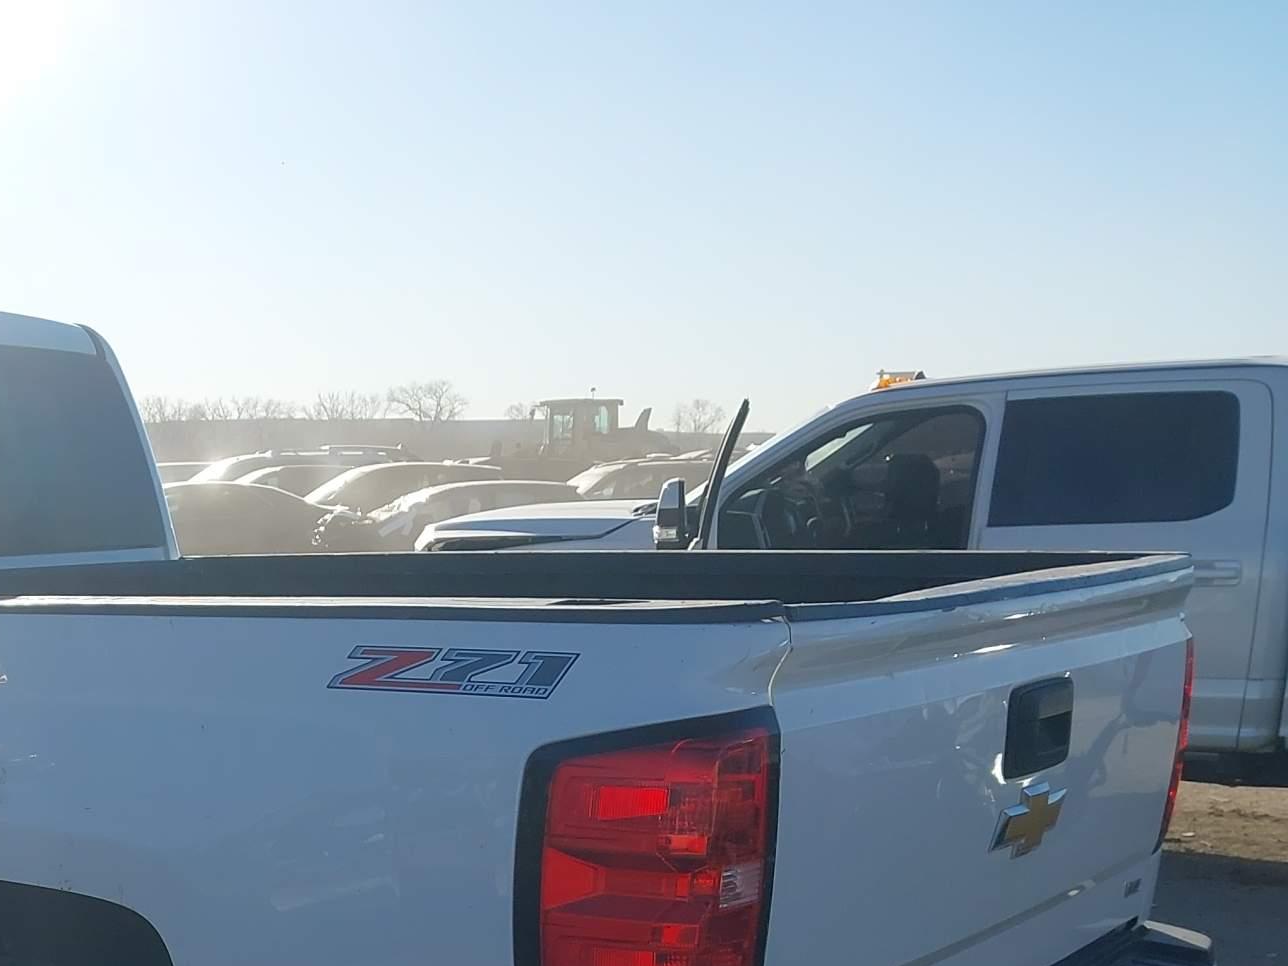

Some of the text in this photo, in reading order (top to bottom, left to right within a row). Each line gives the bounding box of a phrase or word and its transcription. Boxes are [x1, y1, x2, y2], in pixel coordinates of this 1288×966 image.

[326, 645, 581, 699] Z71
[462, 684, 548, 696] OFF ROAD
